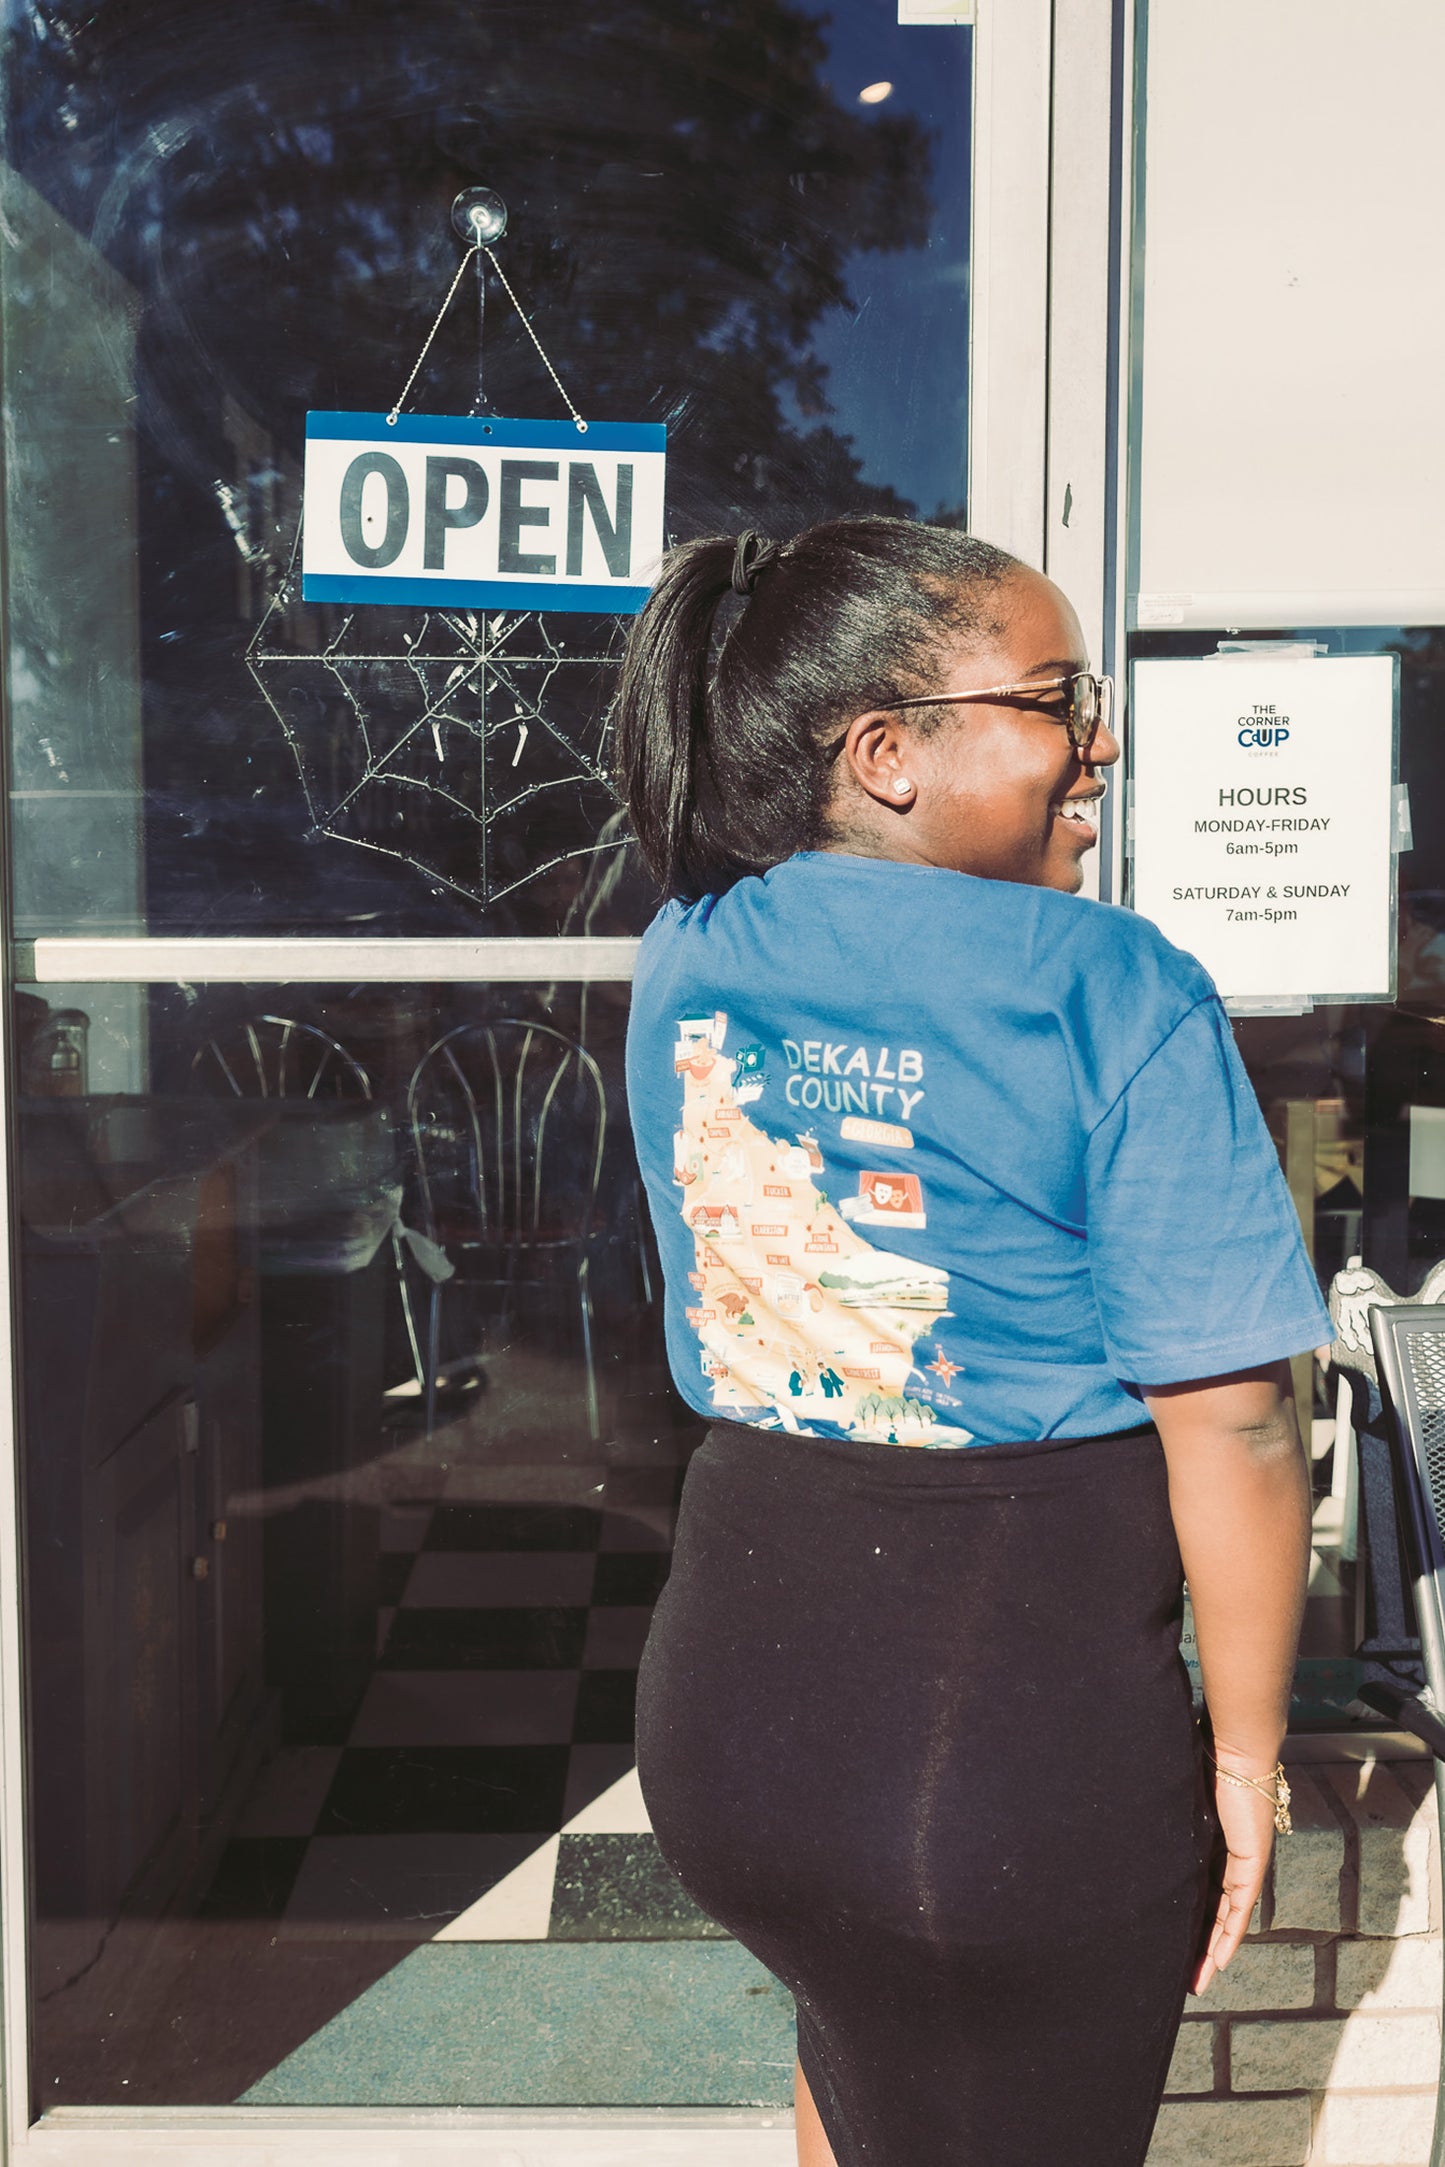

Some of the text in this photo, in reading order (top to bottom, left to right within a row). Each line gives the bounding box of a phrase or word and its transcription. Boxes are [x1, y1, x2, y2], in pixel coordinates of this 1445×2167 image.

[339, 451, 634, 578] OPEN
[1252, 704, 1276, 715] THE
[1237, 715, 1290, 727] CORNER
[1237, 728, 1290, 748] CUP
[1219, 786, 1308, 807] HOURS
[1194, 818, 1331, 833] MONDAY-FRIDAY
[1226, 841, 1298, 857] 6am-5pm
[1172, 884, 1351, 901] SATURDAY & SUNDAY
[1225, 908, 1297, 924] 7am-5pm
[781, 1039, 924, 1083] DEKALB
[785, 1074, 925, 1120] COUNTY
